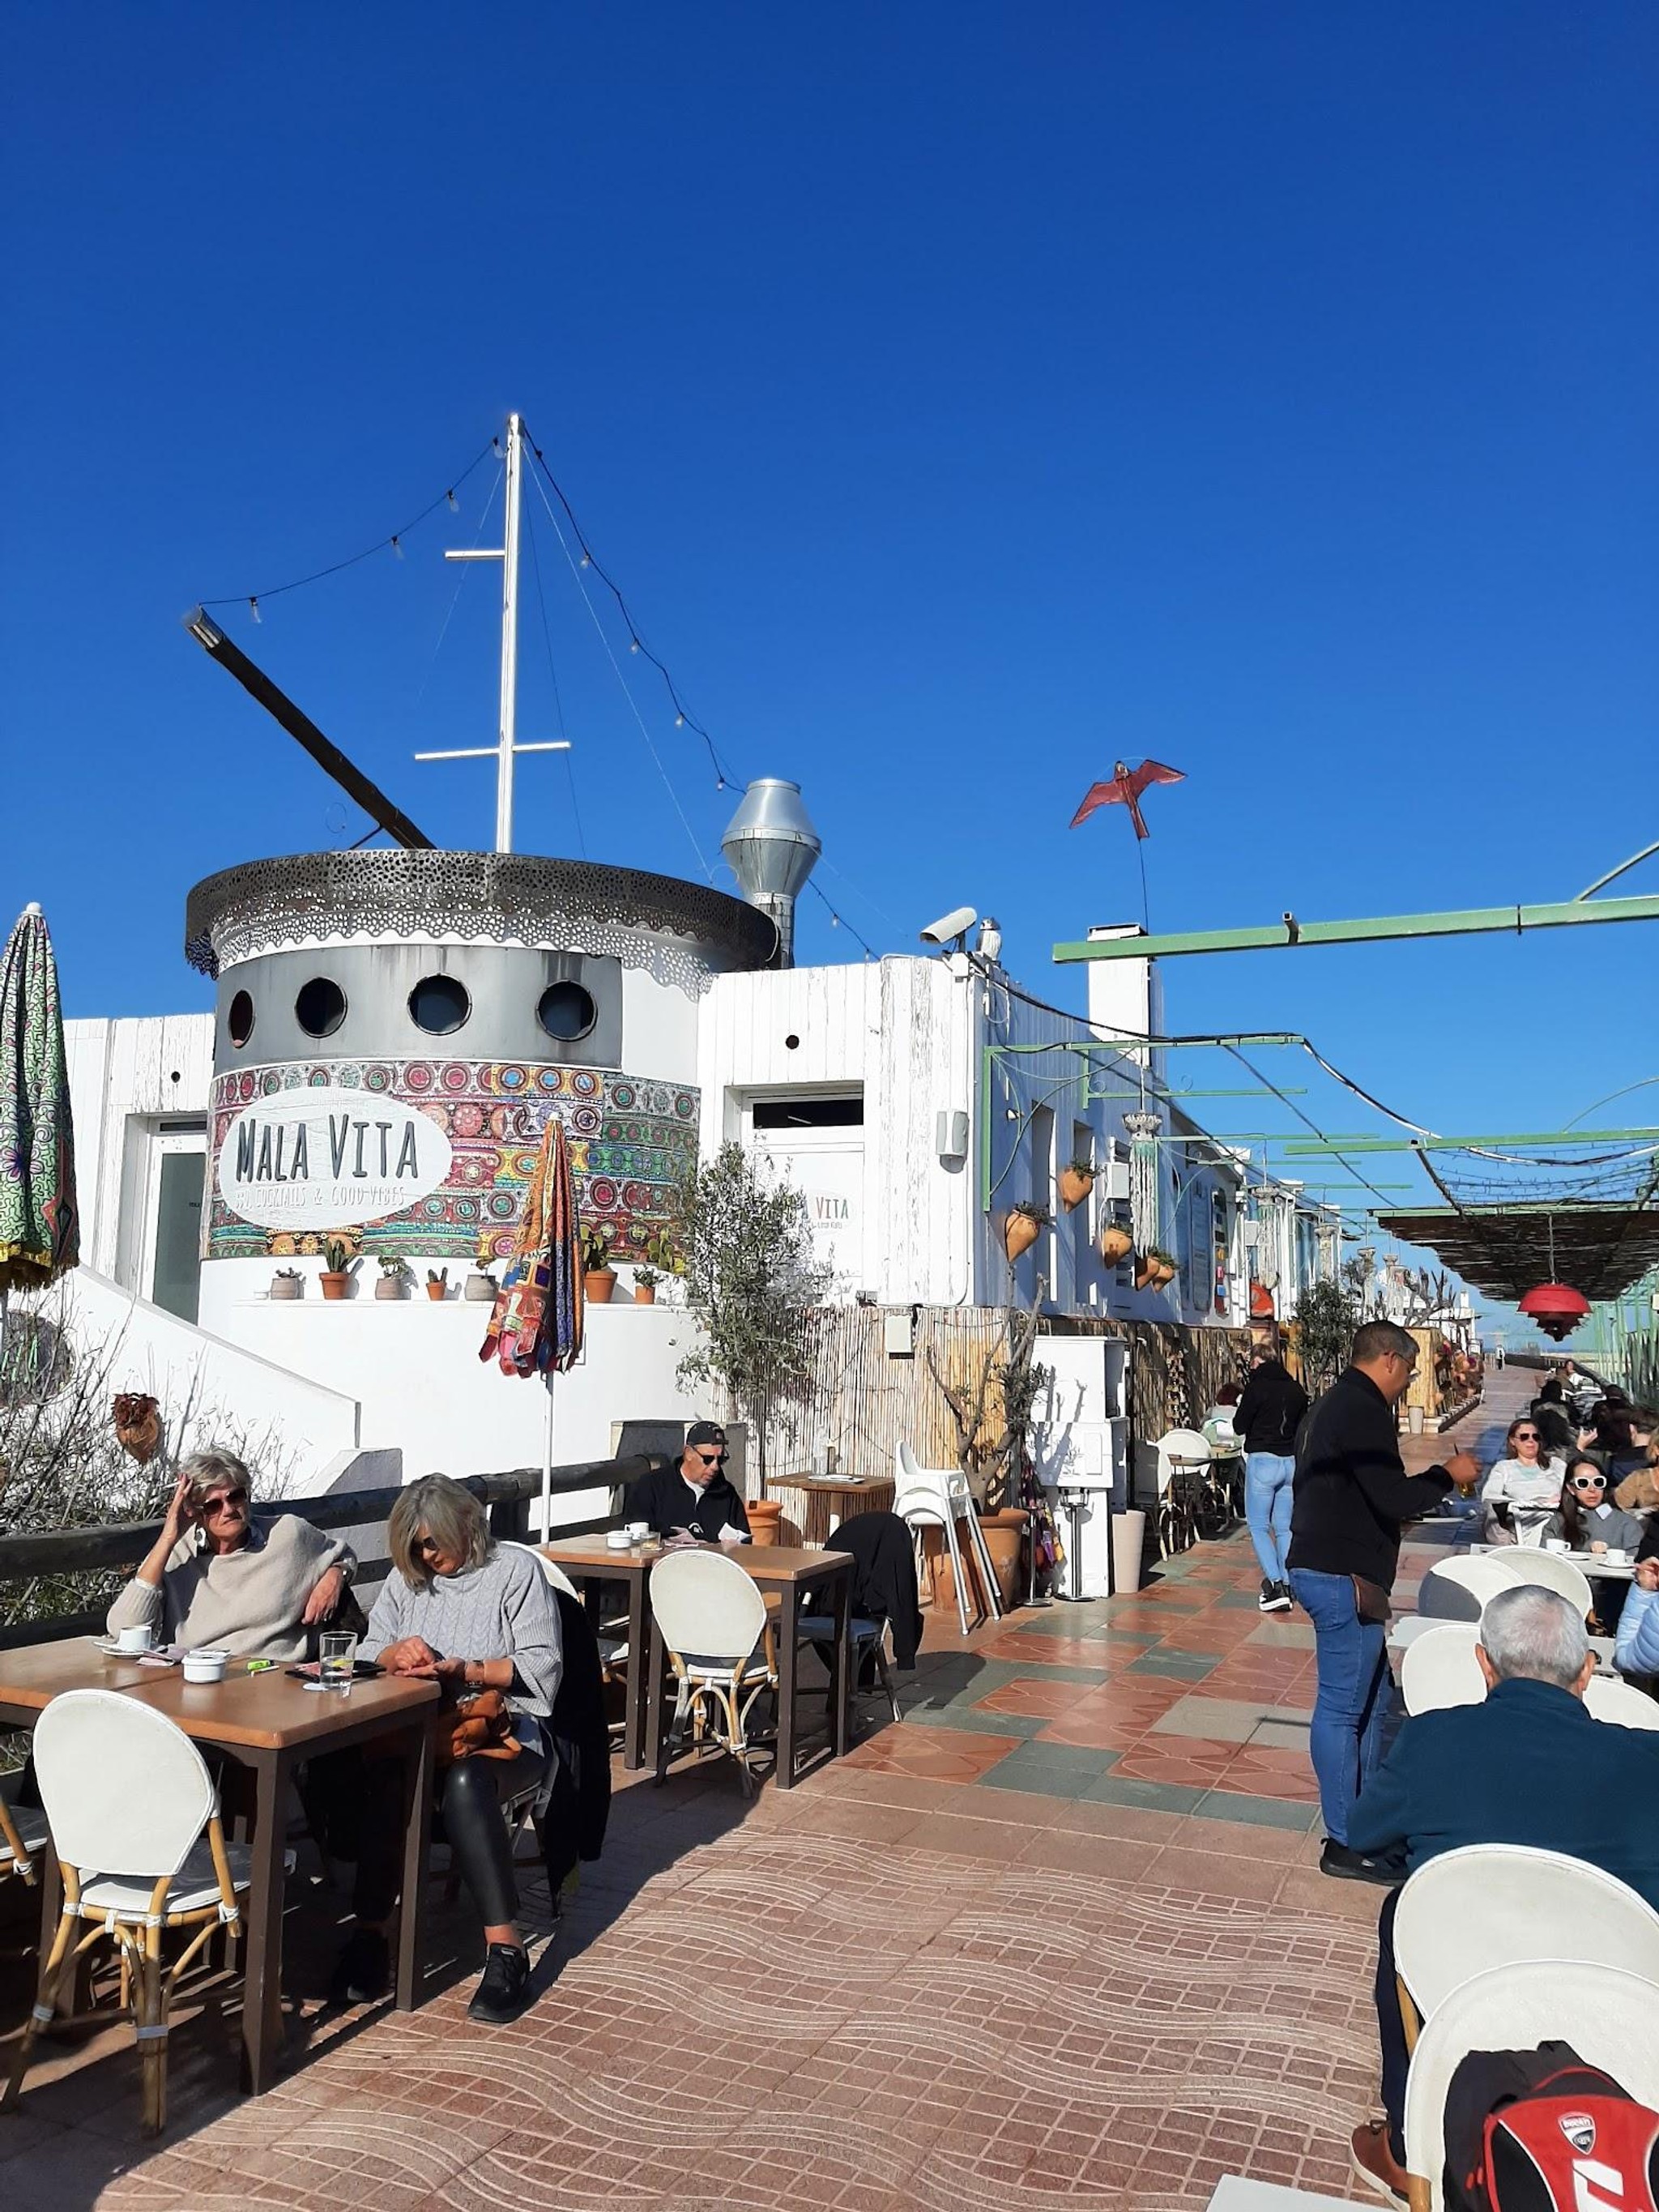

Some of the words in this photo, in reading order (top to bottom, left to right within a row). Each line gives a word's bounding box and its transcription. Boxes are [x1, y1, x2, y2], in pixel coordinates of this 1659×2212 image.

[236, 1119, 309, 1183] MALA
[329, 1114, 418, 1180] VITA
[816, 1196, 849, 1219] VITA
